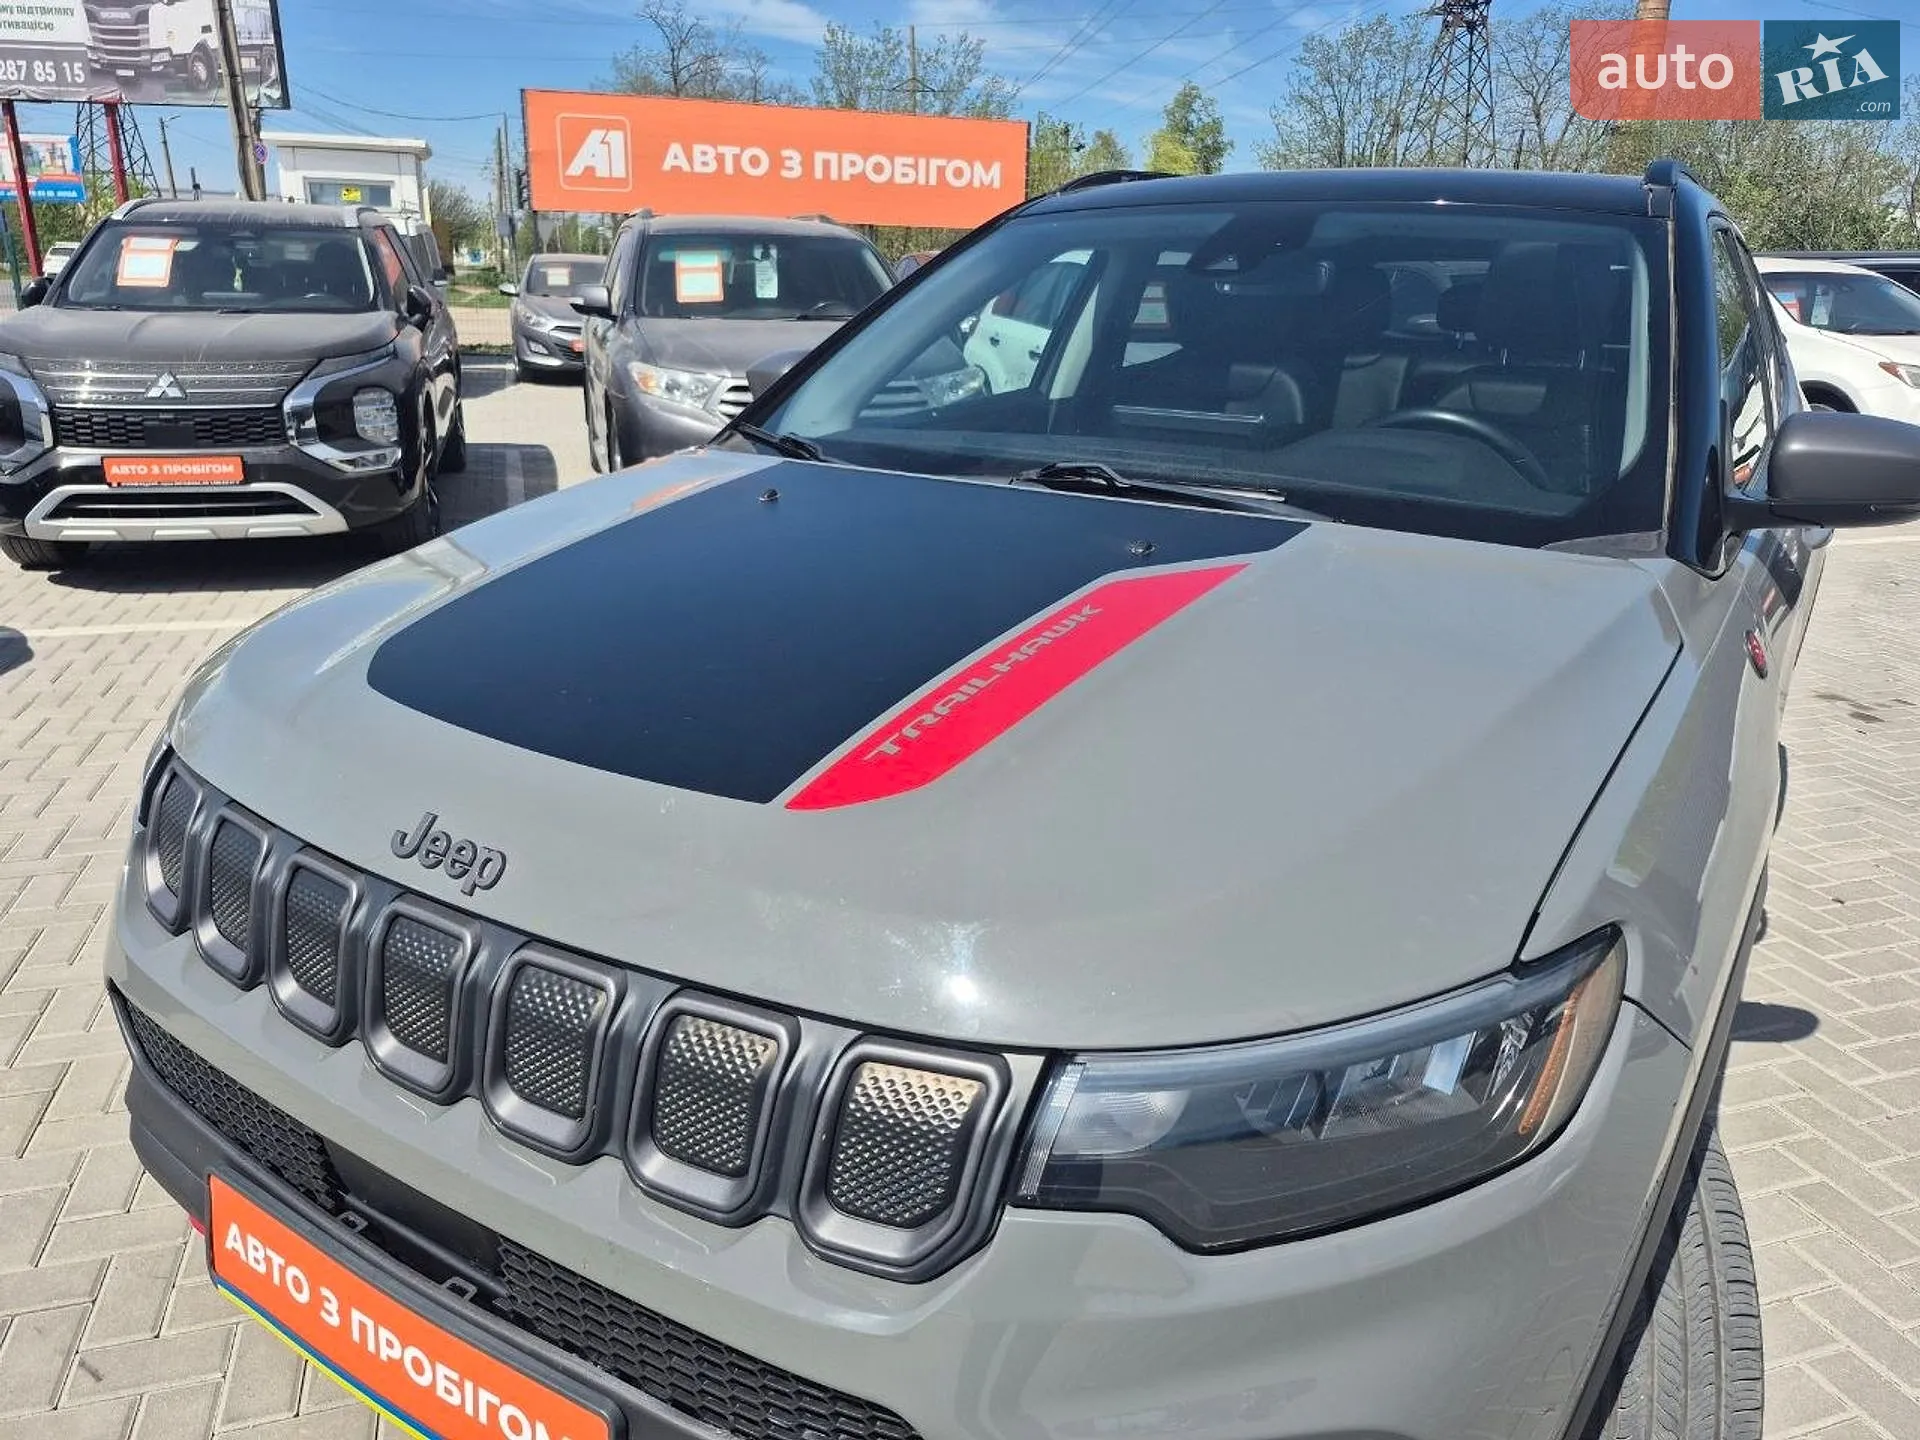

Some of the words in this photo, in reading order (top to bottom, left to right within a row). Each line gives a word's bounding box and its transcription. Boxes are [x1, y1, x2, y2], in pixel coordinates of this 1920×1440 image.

[16, 4, 75, 17] підтримку
[0, 59, 27, 81] 287
[33, 60, 57, 82] 85
[62, 61, 86, 84] 15
[661, 142, 769, 177] АВТО
[780, 147, 803, 179] З
[813, 151, 1001, 189] ПРОБІГОМ
[111, 464, 148, 475] АВТО
[151, 464, 160, 475] З
[163, 463, 235, 475] ПРОБІГОМ
[863, 603, 1103, 760] TRAILHAWK
[391, 811, 507, 897] Jeep
[224, 1222, 311, 1305] АВТО
[319, 1285, 341, 1328] З
